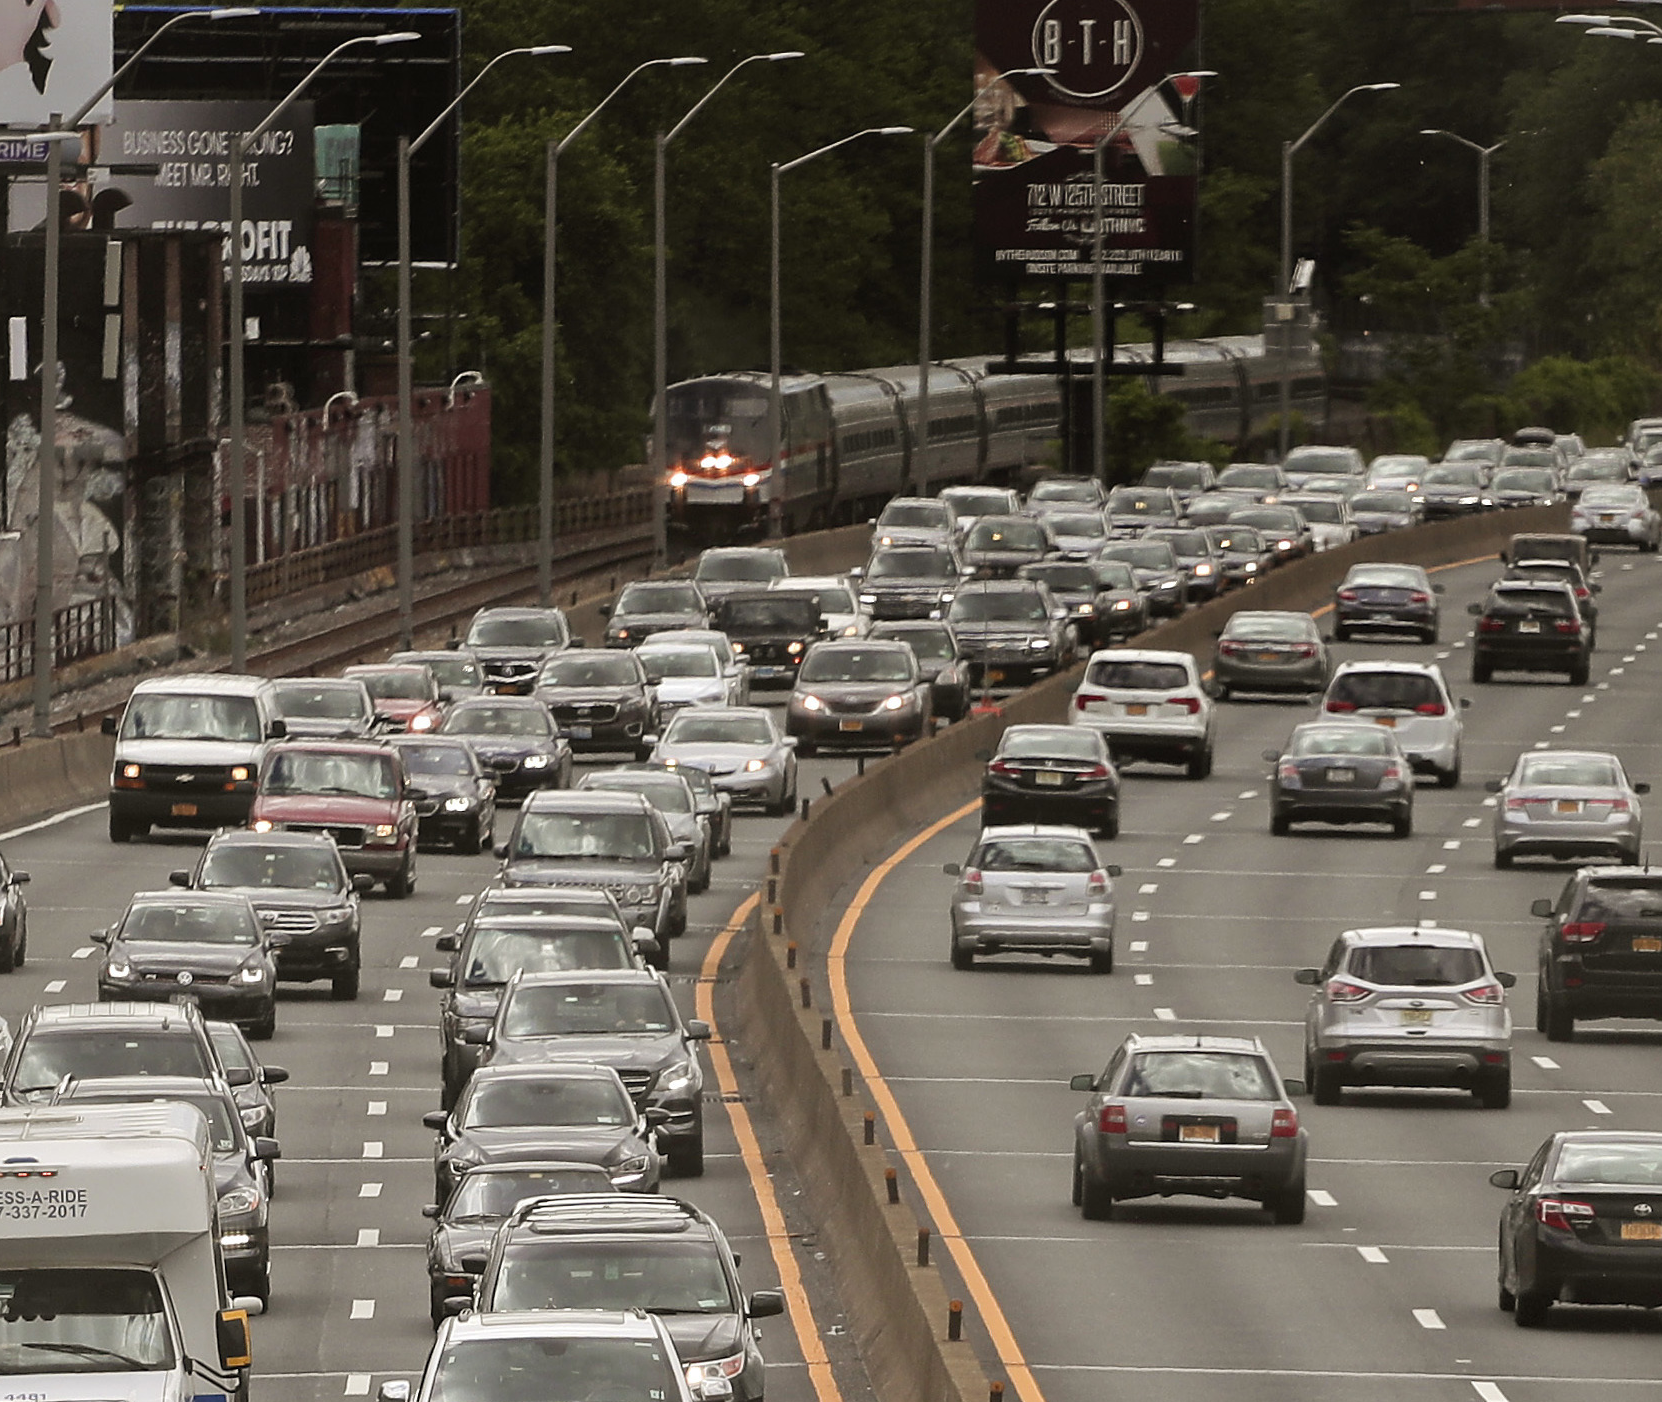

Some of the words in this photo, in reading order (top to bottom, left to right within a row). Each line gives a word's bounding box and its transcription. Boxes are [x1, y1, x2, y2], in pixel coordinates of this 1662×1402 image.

[124, 131, 185, 155] BUSINESS
[189, 131, 229, 155] GONE
[229, 131, 295, 155] RONG?
[155, 163, 188, 187] MEET
[217, 163, 260, 187] RIHT.
[1100, 184, 1146, 206] STREET
